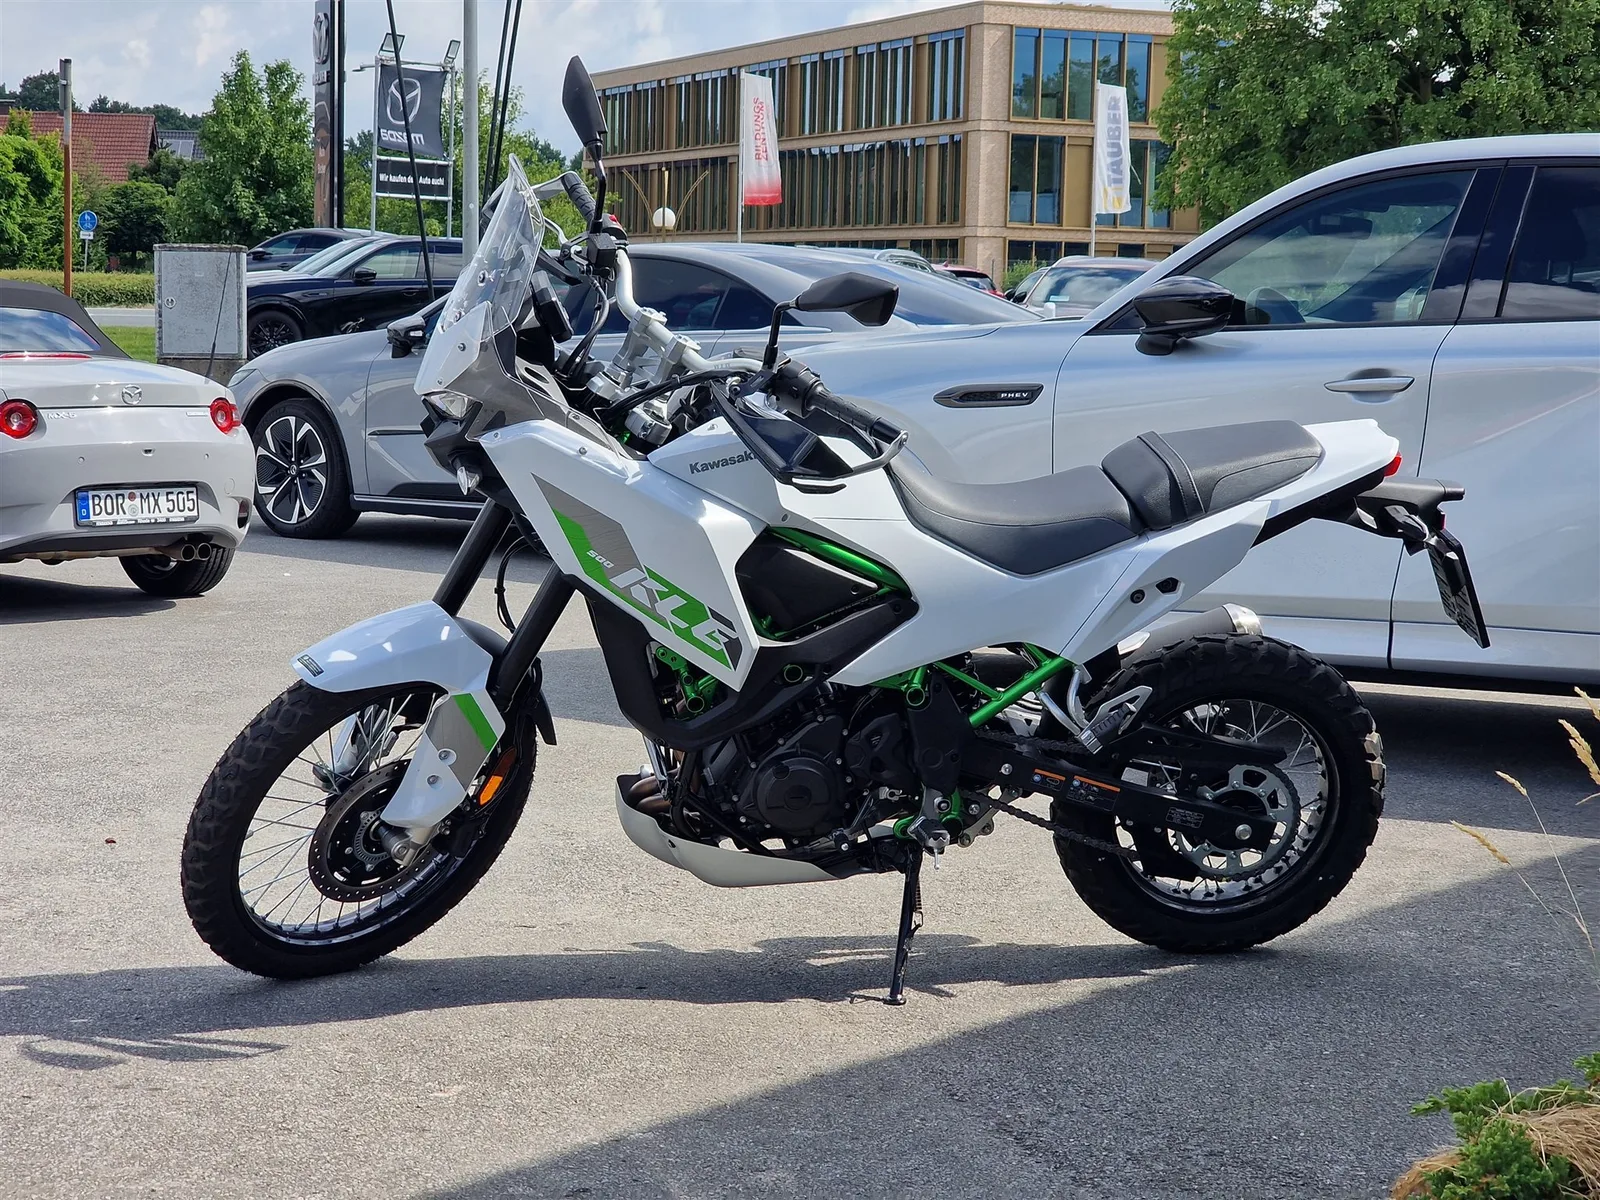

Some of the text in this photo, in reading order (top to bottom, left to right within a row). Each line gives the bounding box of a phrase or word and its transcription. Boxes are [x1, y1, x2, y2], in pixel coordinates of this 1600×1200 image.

[753, 97, 761, 161] BILDUNGS
[1106, 95, 1125, 187] TAUBER
[379, 173, 388, 182] Wir
[389, 173, 407, 183] kaufen
[418, 175, 431, 185] Auto
[46, 411, 76, 419] MX-5
[81, 490, 196, 517] D BOR MX 505
[586, 549, 615, 569] 500
